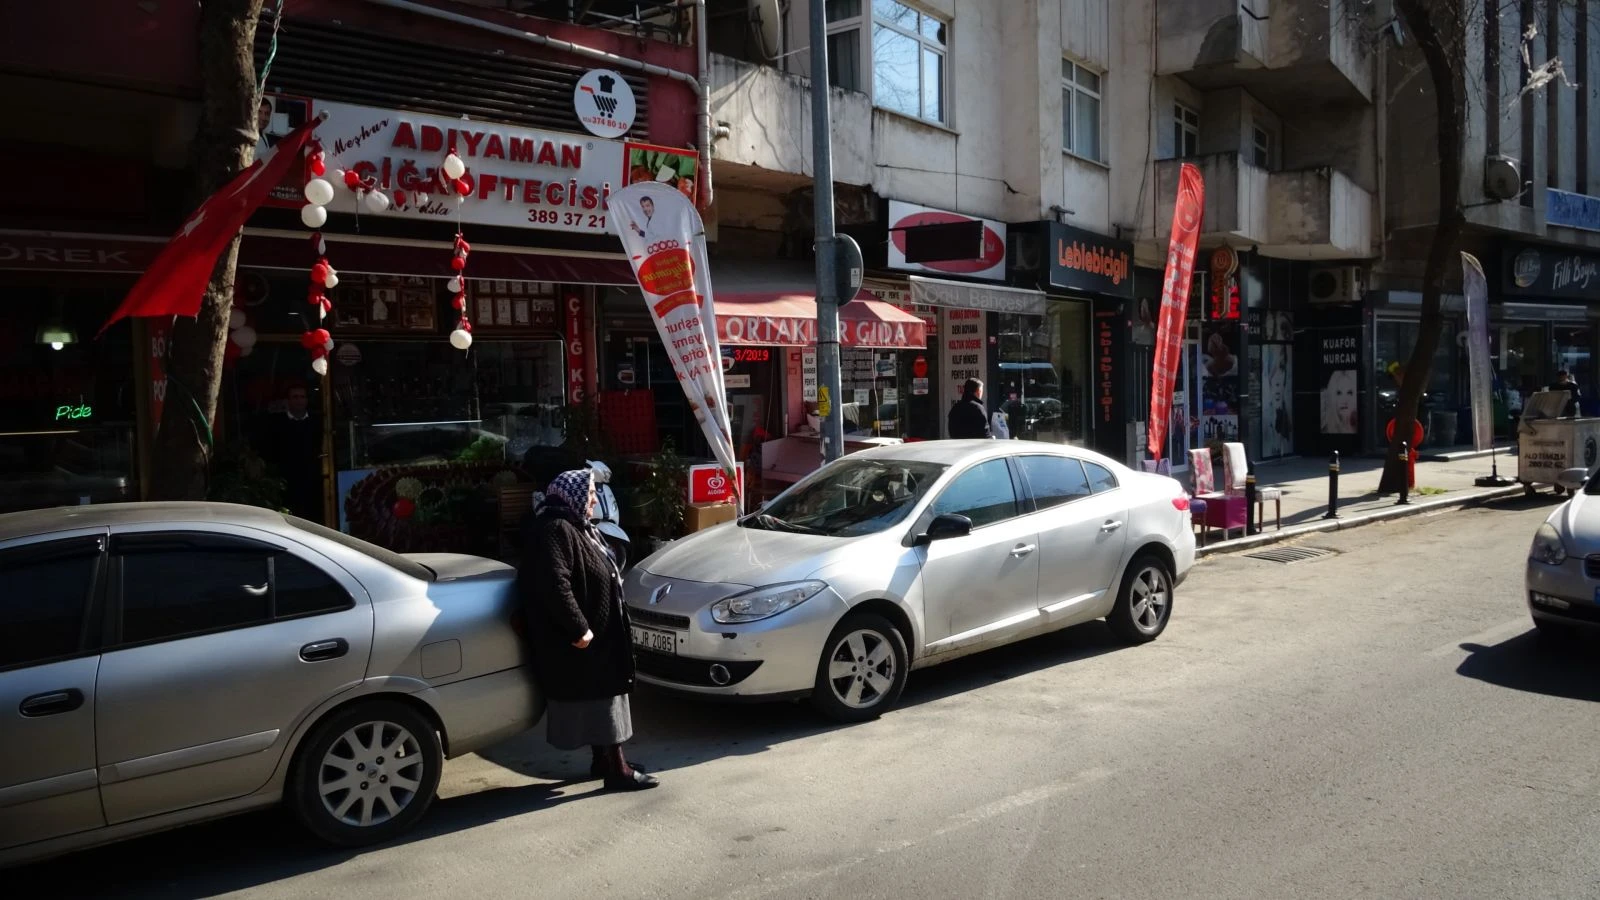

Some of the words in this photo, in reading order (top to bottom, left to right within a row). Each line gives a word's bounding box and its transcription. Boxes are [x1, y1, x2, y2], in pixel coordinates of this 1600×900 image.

[391, 121, 582, 170] ADIYAMAN
[528, 209, 558, 225] 389
[564, 212, 584, 227] 37
[589, 214, 607, 229] 21
[1552, 256, 1572, 290] Filli
[1572, 256, 1598, 289] Boya
[726, 316, 848, 343] ORTAKLR
[856, 319, 905, 343] GIDA
[1323, 336, 1356, 349] KUAFÖR
[1323, 353, 1357, 364] NURCAN
[55, 404, 92, 420] Pide
[652, 633, 672, 651] 2085
